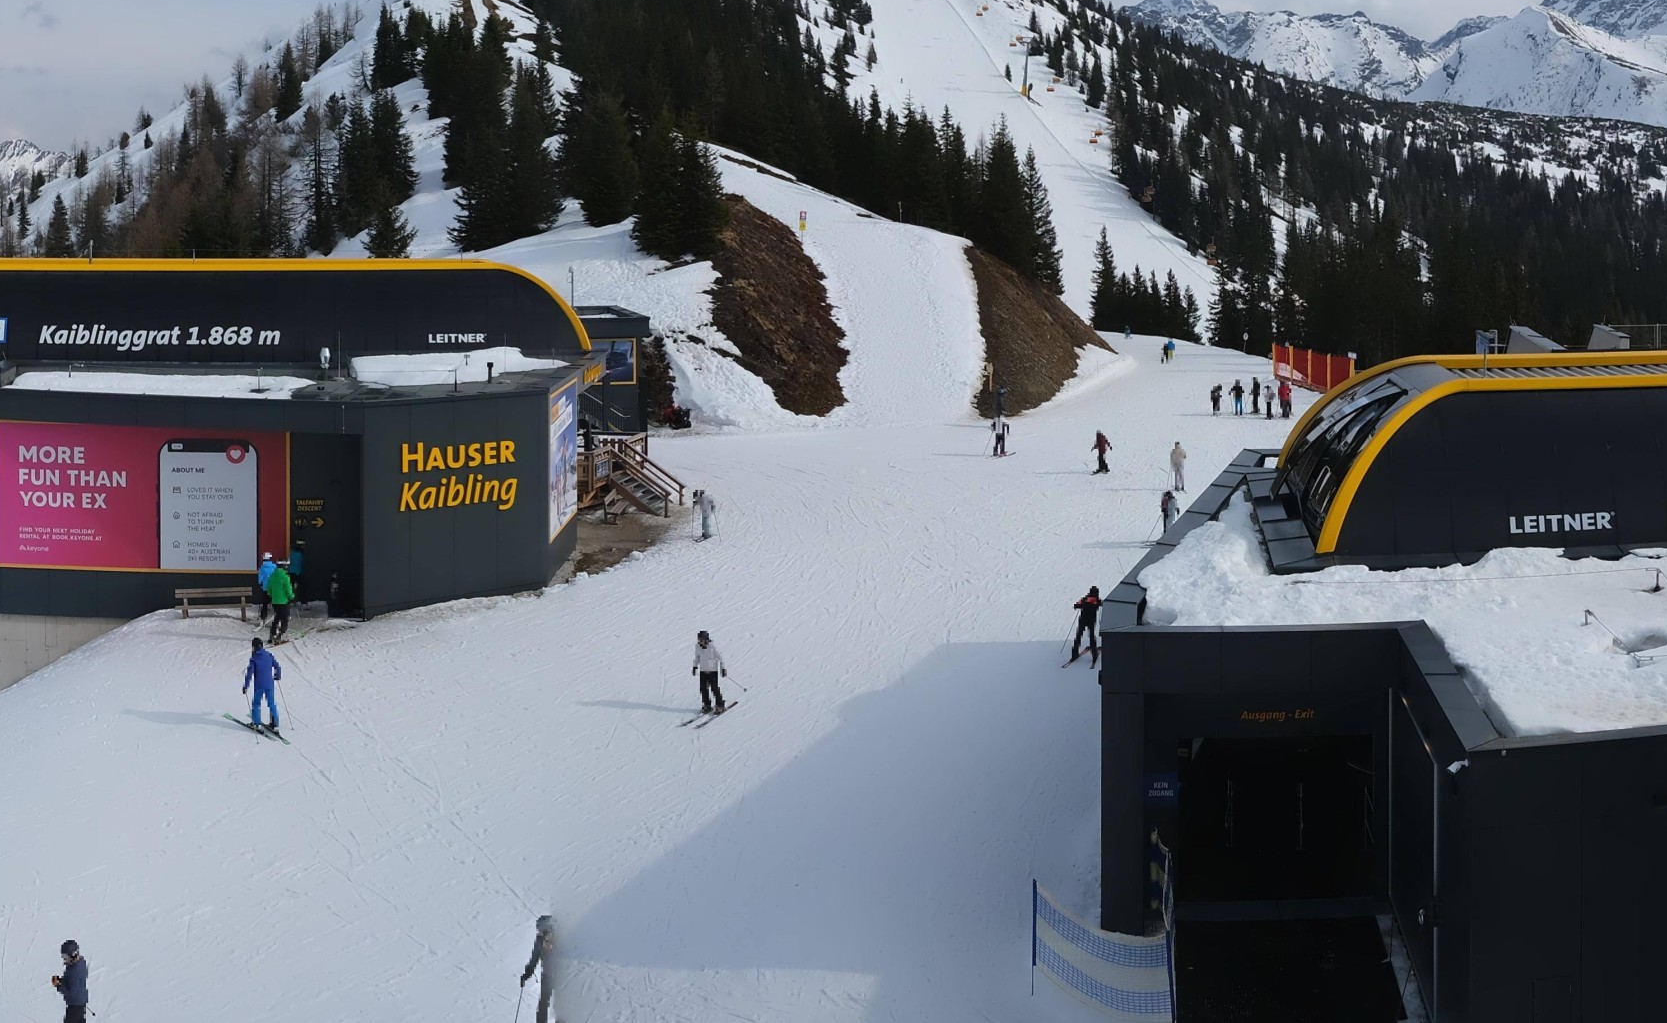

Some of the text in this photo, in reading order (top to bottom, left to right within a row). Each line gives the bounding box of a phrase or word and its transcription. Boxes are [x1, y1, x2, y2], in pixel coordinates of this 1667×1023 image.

[38, 324, 281, 351] Kaiblinggrat 1.868 m
[18, 445, 85, 464] MORE
[401, 440, 516, 473] HAUSER
[19, 468, 127, 488] FUN THAN
[19, 491, 107, 509] YOUR EX
[400, 474, 518, 512] Kaibling
[27, 545, 50, 553] keyone
[1241, 710, 1286, 722] Ausgang
[1295, 709, 1315, 719] Exit
[1153, 781, 1169, 789] KEIN
